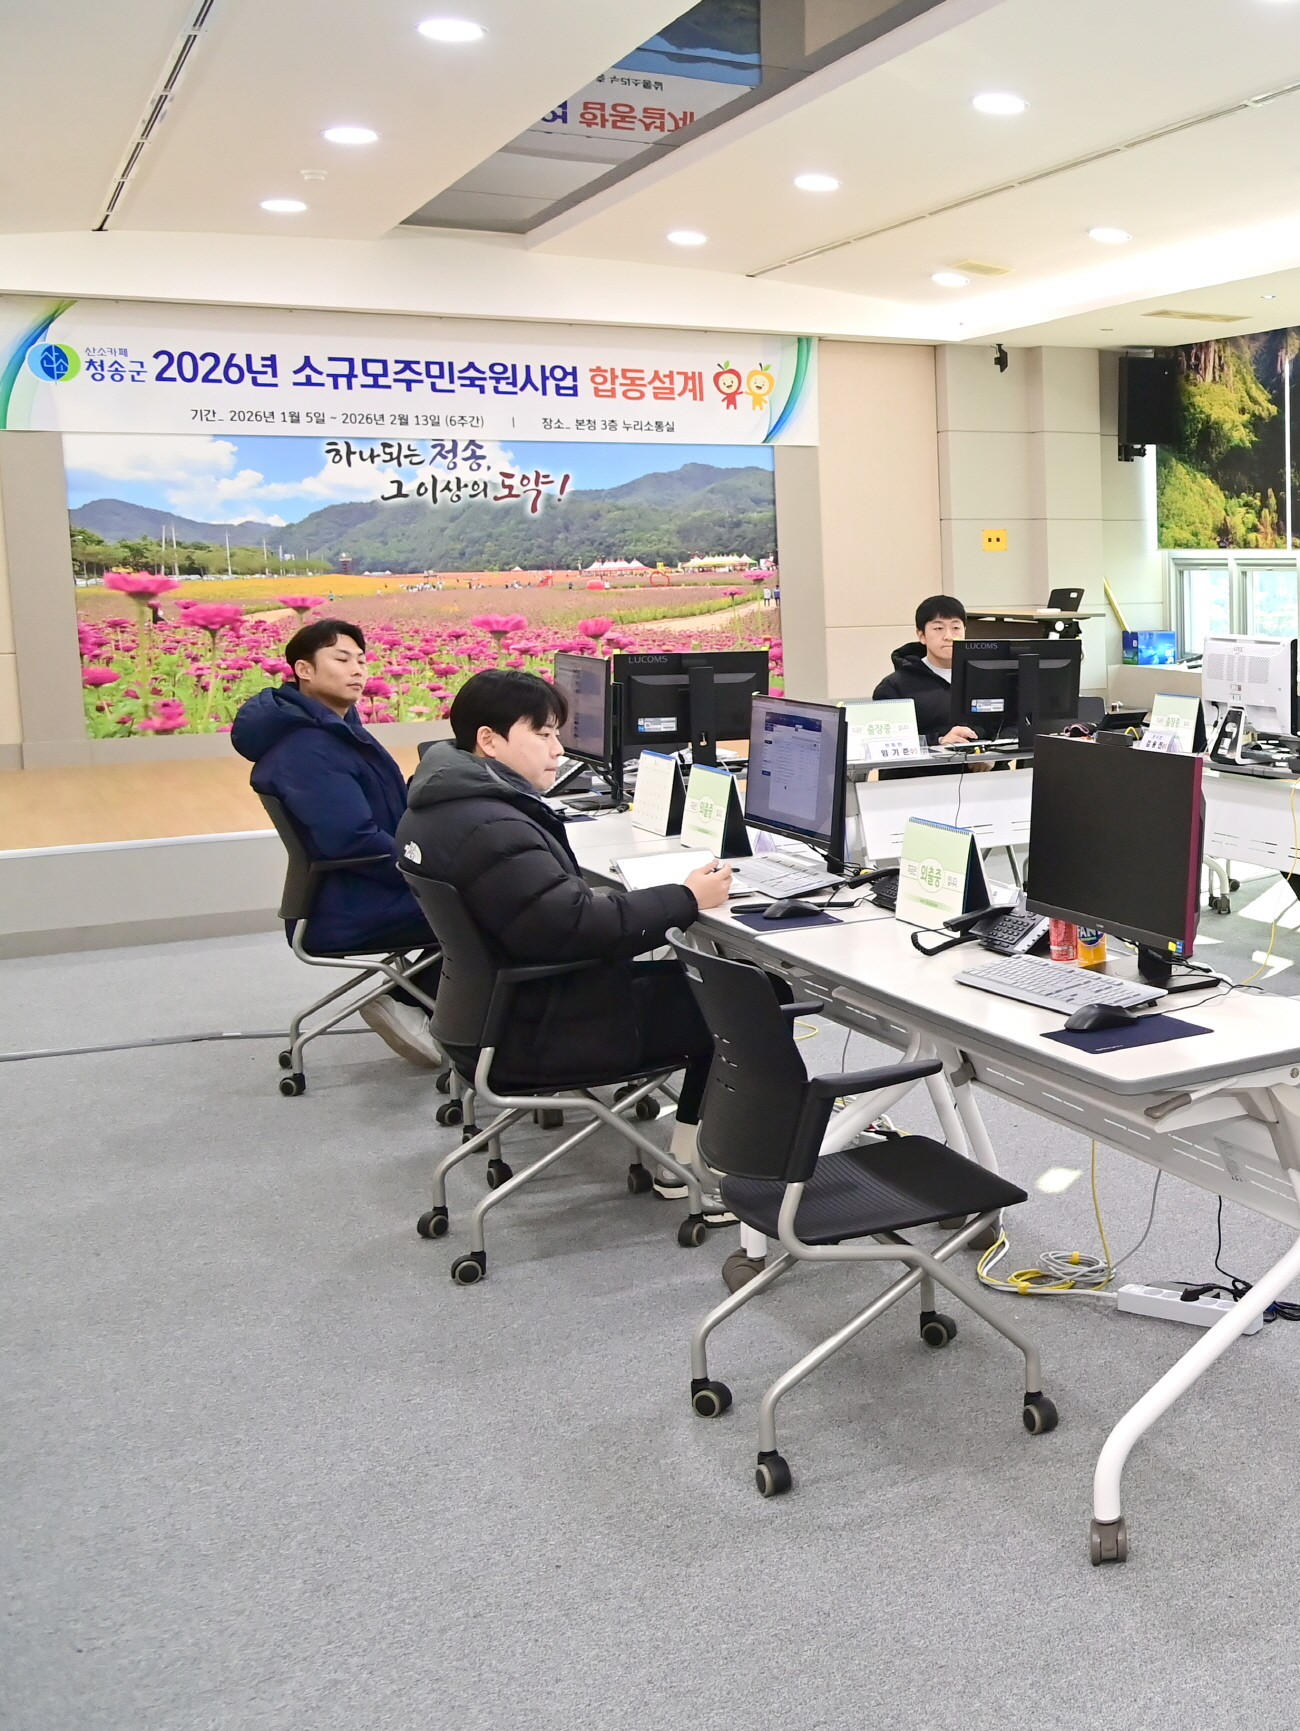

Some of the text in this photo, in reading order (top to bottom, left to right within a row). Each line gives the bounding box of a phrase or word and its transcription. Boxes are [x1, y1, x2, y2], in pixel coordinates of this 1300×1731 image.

[85, 347, 128, 357] 산소카페
[84, 358, 148, 383] 청송군
[152, 350, 705, 402] 2026년 소규모주민숙원사업 합동설계
[229, 410, 275, 423] 2026년
[280, 411, 301, 424] 1월
[305, 411, 326, 424] 5일
[341, 412, 385, 426] 2026년
[389, 413, 409, 426] 2월
[414, 414, 441, 427] 13일
[445, 414, 485, 428] (6주간)
[575, 418, 597, 431] 본청
[600, 419, 618, 432] 3층
[622, 420, 675, 433] 누리소통실
[325, 441, 426, 467] 하나되는
[381, 470, 570, 514] 그 이상의 도약!
[628, 655, 668, 664] LUCOMS
[867, 723, 891, 735] 출장중
[920, 865, 942, 888] 외출중
